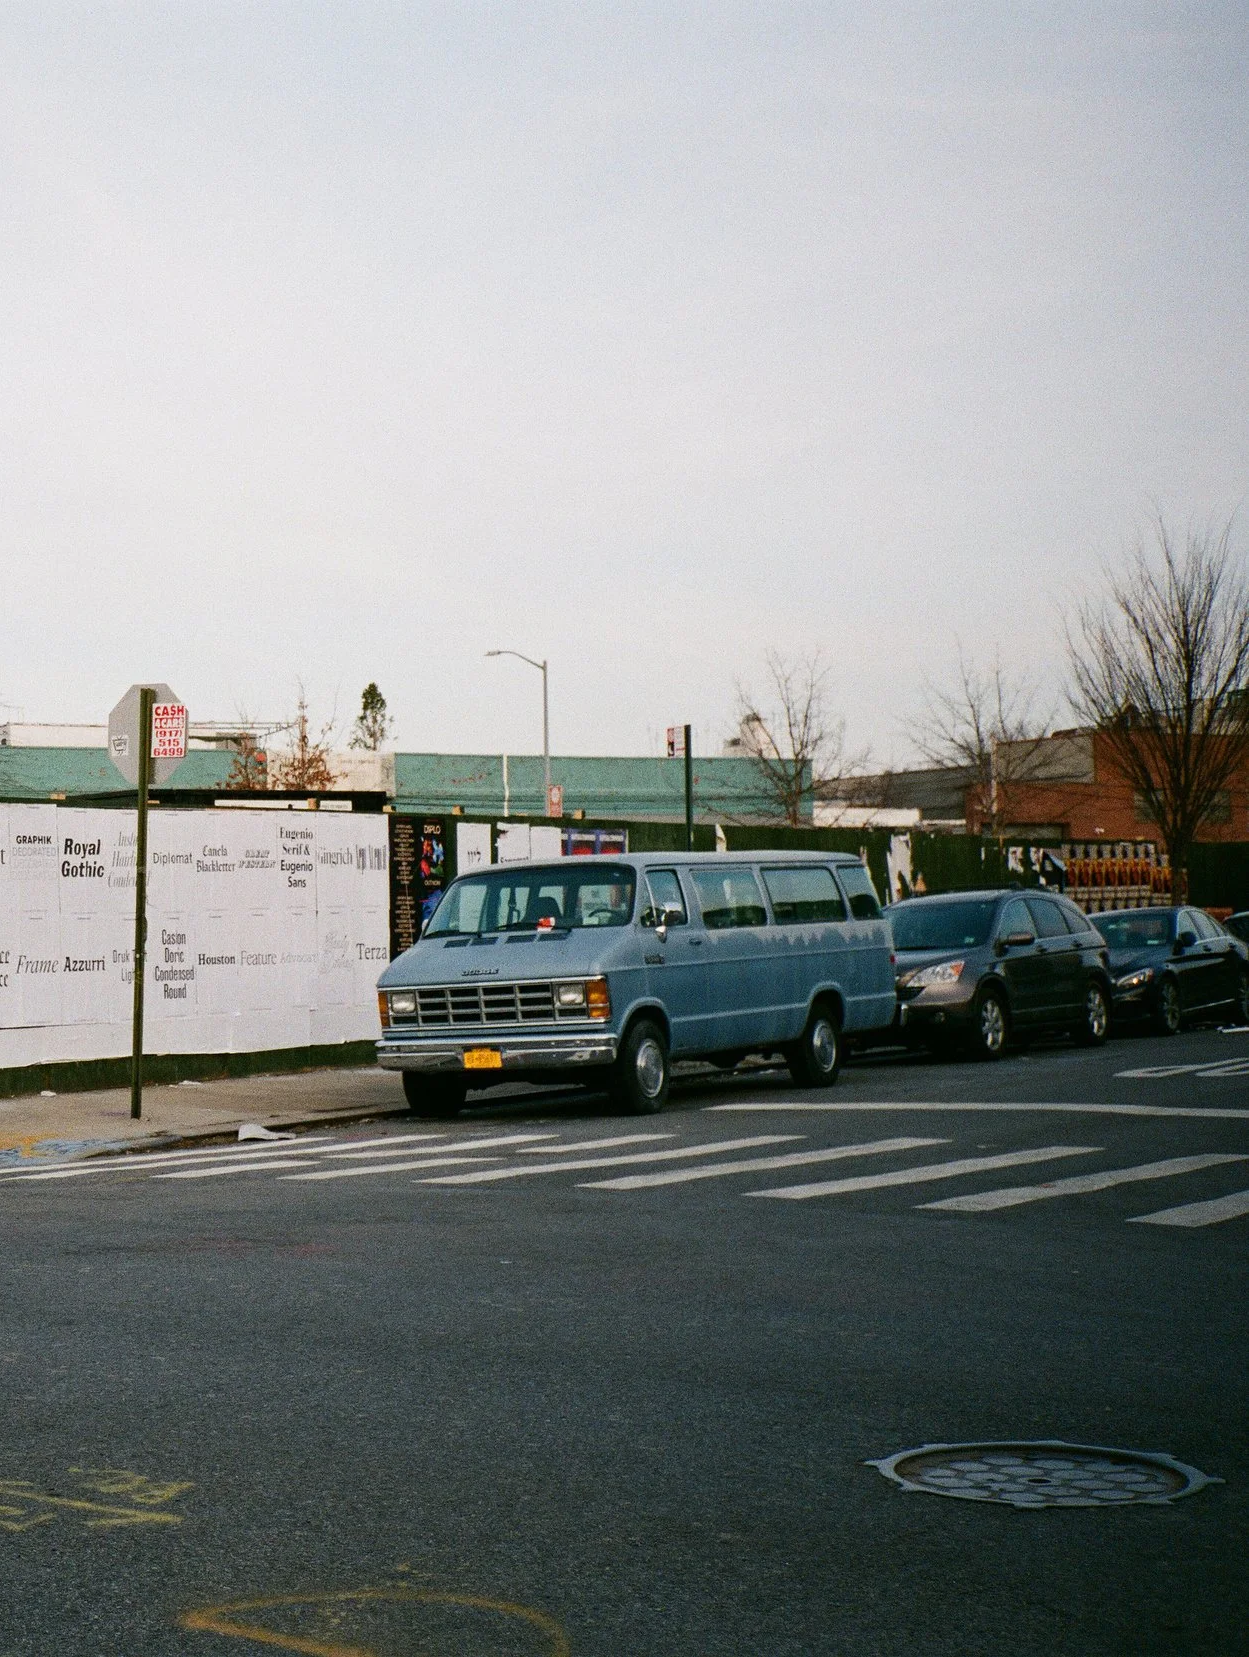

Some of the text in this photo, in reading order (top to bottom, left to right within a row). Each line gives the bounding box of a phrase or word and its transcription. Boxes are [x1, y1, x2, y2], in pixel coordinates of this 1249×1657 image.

[155, 730, 182, 738] (917)
[159, 739, 179, 747] 515
[153, 748, 183, 756] 6499
[280, 827, 313, 840] Eugenio
[423, 825, 441, 834] DIPLO
[16, 835, 52, 845] GRAPHIK
[64, 838, 101, 857] Royal
[153, 852, 193, 866] Diplomat
[61, 861, 104, 878] Gothic
[281, 860, 313, 874] Eugenio
[288, 876, 306, 888] Sans
[164, 947, 184, 963] Doric
[241, 950, 277, 966] Feature
[356, 943, 388, 960] Terza
[16, 955, 59, 975] Frame
[63, 956, 105, 972] Azzurri
[198, 954, 235, 965] Houston
[155, 966, 194, 981] Condensed
[163, 984, 187, 999] Round
